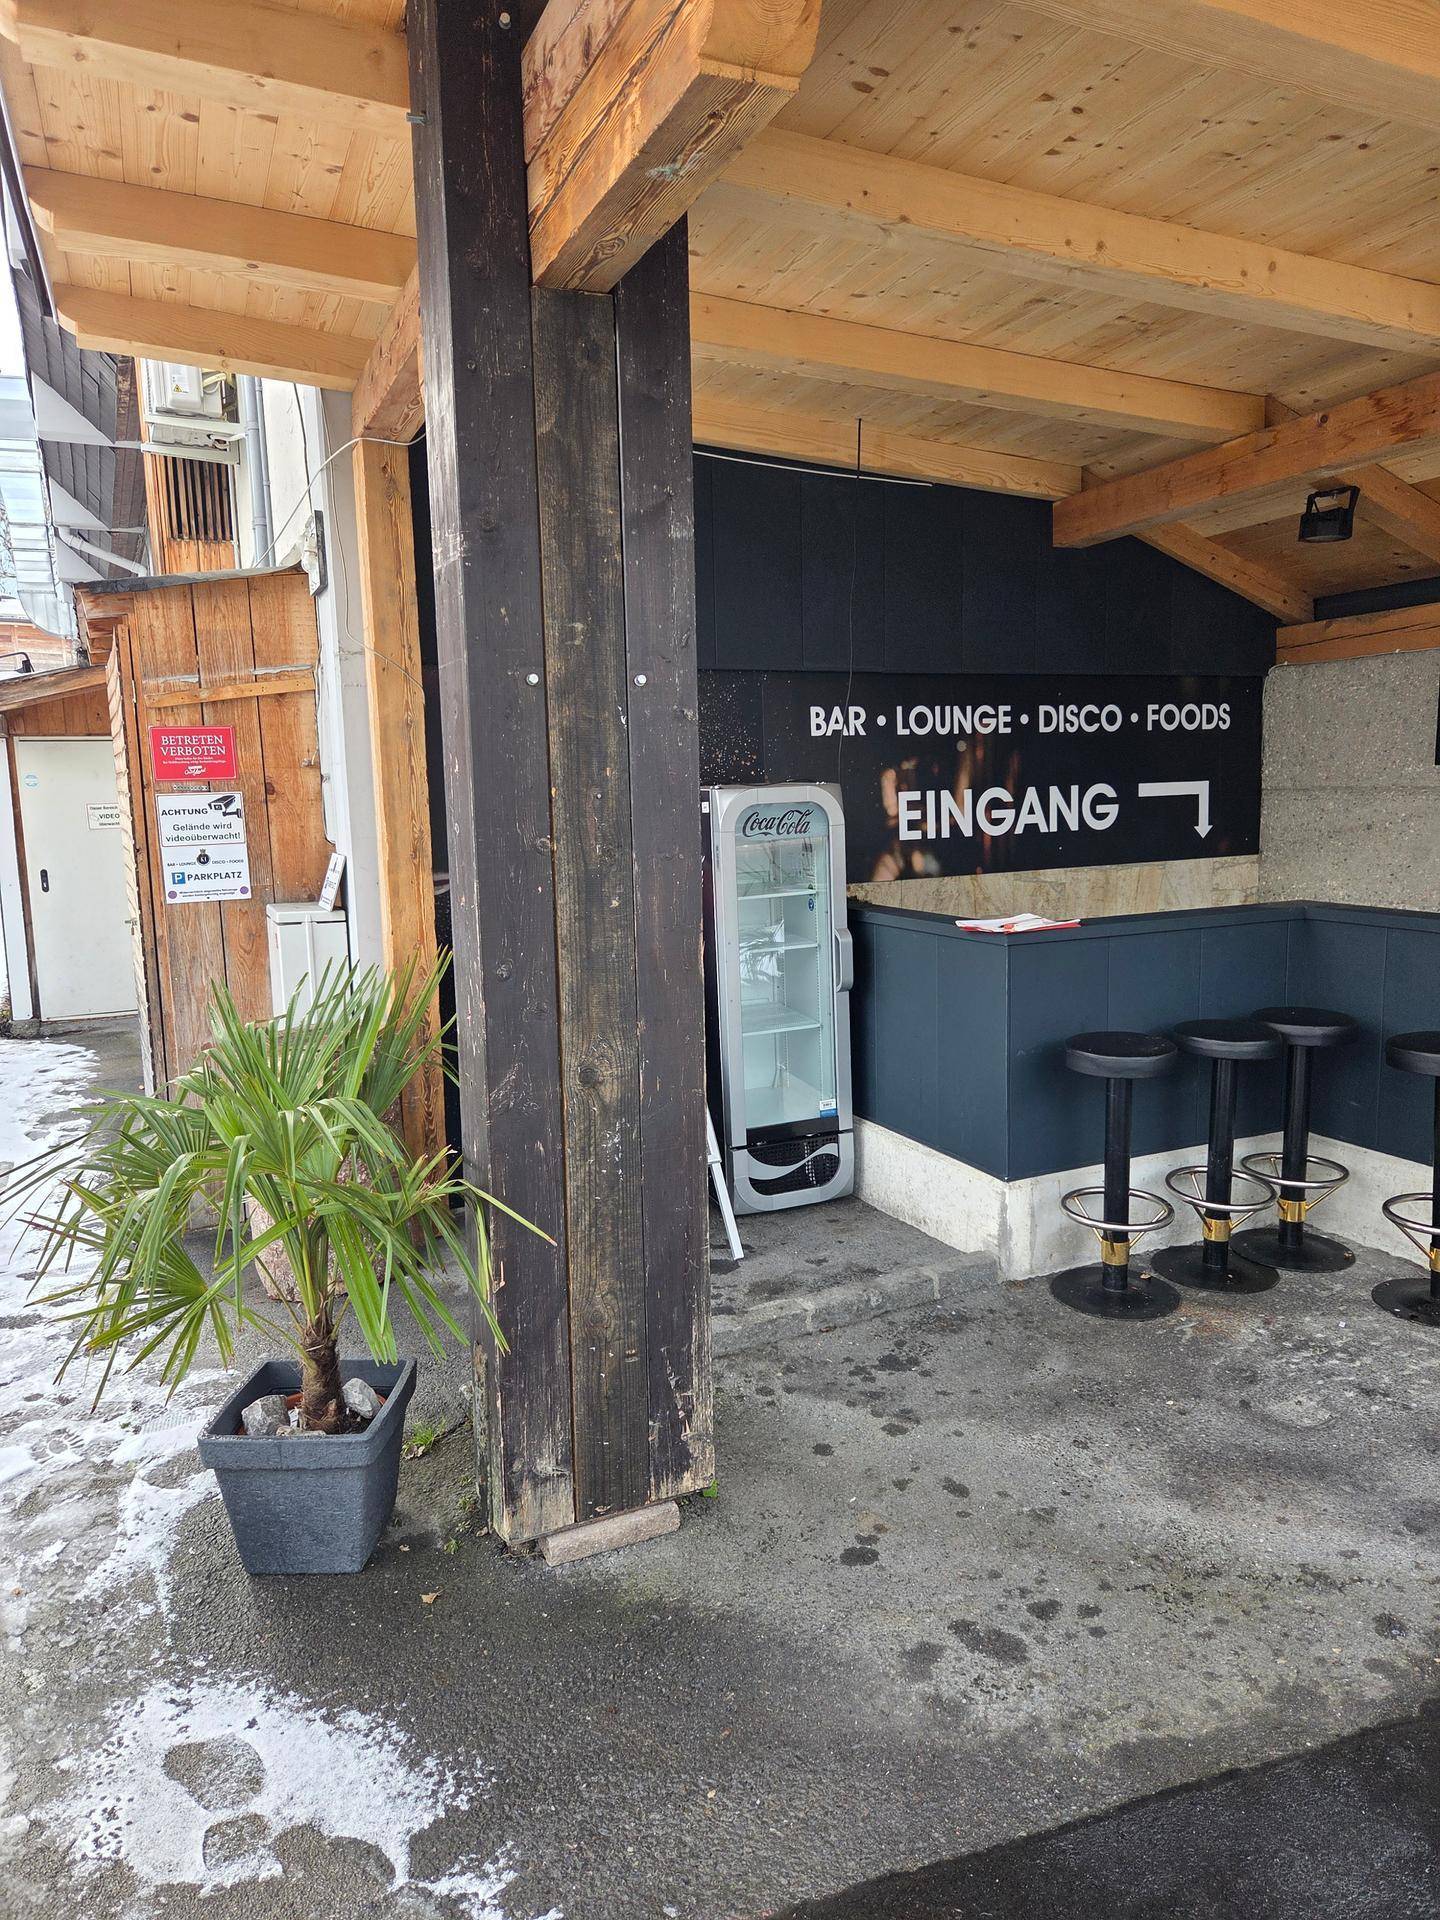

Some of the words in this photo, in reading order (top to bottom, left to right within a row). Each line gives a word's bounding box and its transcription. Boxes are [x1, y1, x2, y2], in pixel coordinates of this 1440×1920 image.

[809, 706, 867, 737] BAR
[896, 705, 1012, 736] LOUNGE
[1038, 704, 1123, 733] DISCO
[1147, 703, 1231, 731] FOODS
[161, 735, 224, 745] BETRETEN
[160, 745, 226, 756] VERBOTEN
[161, 808, 208, 816] ACHTUNG
[898, 783, 1120, 841] EINGANG
[172, 822, 211, 831] Gelände
[212, 822, 232, 830] wird
[165, 832, 241, 842] videoüberwacht!
[187, 871, 242, 881] PARKPLATZ
